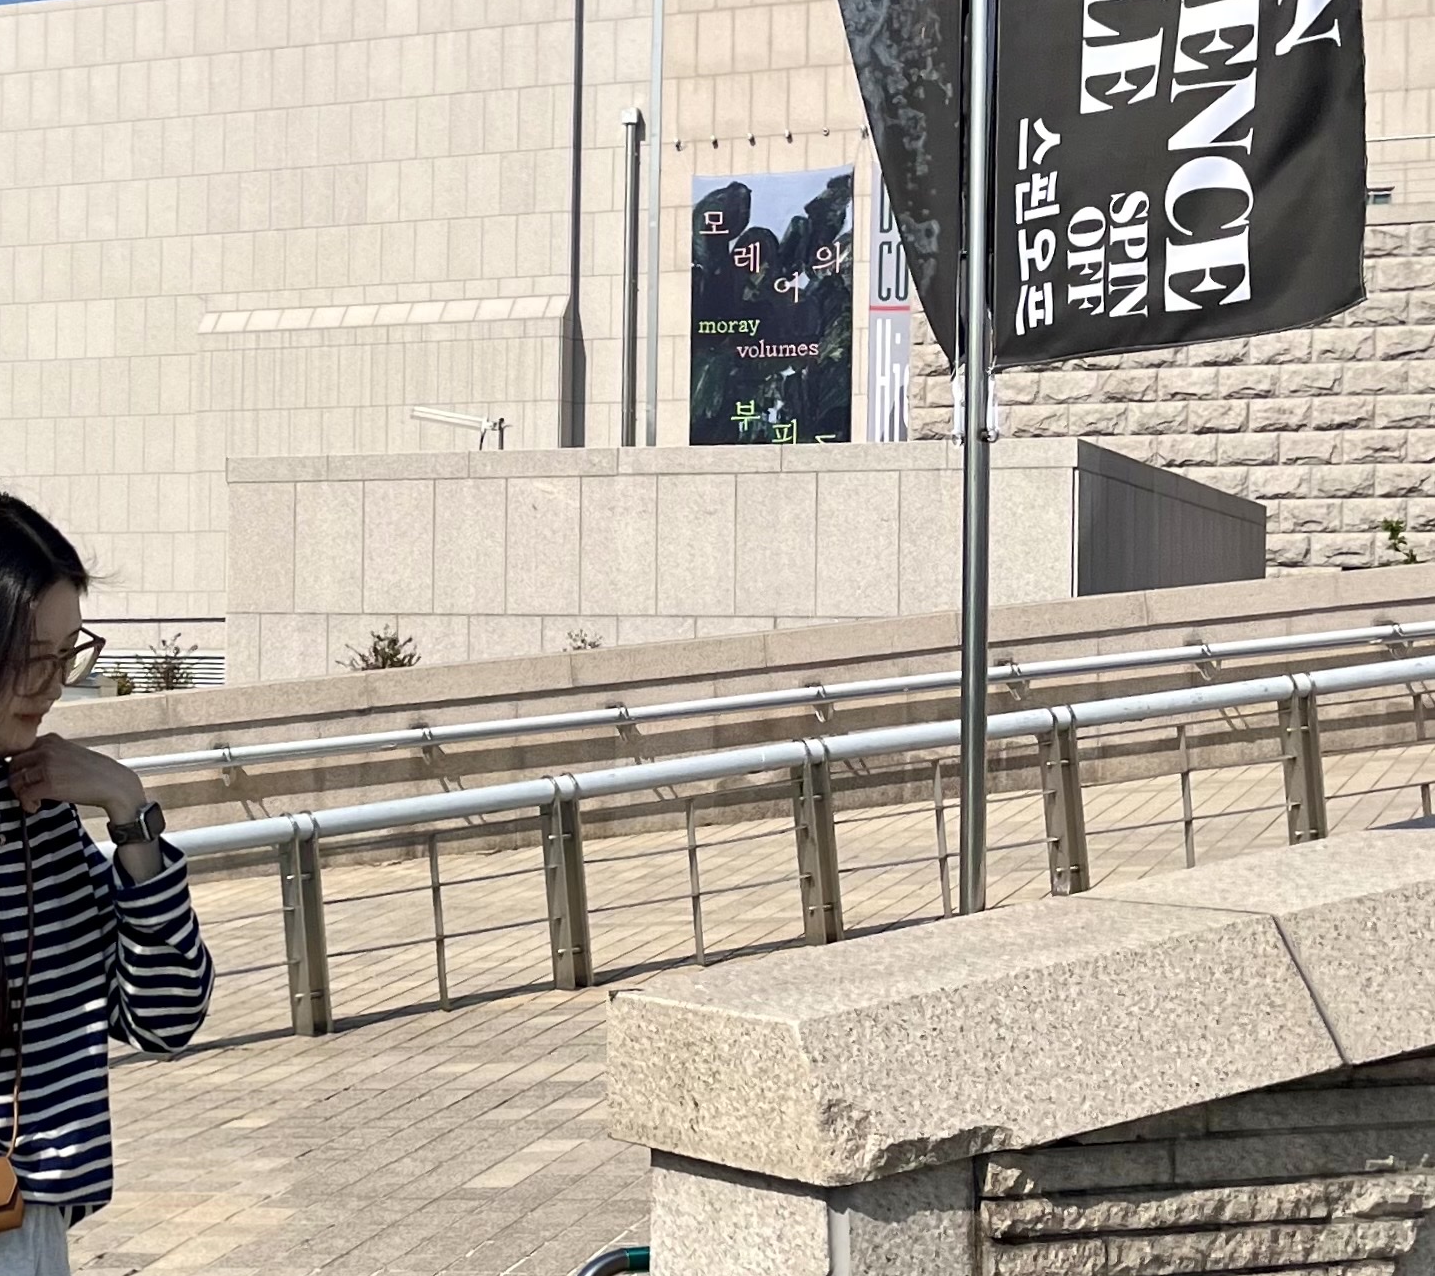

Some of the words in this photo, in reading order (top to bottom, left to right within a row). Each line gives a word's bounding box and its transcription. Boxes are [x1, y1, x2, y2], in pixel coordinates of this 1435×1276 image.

[1015, 118, 1061, 336] 스핀오프
[1067, 206, 1106, 315] OFF
[1109, 191, 1150, 317] SPIN
[698, 318, 760, 335] moray
[737, 340, 819, 358] volumes
